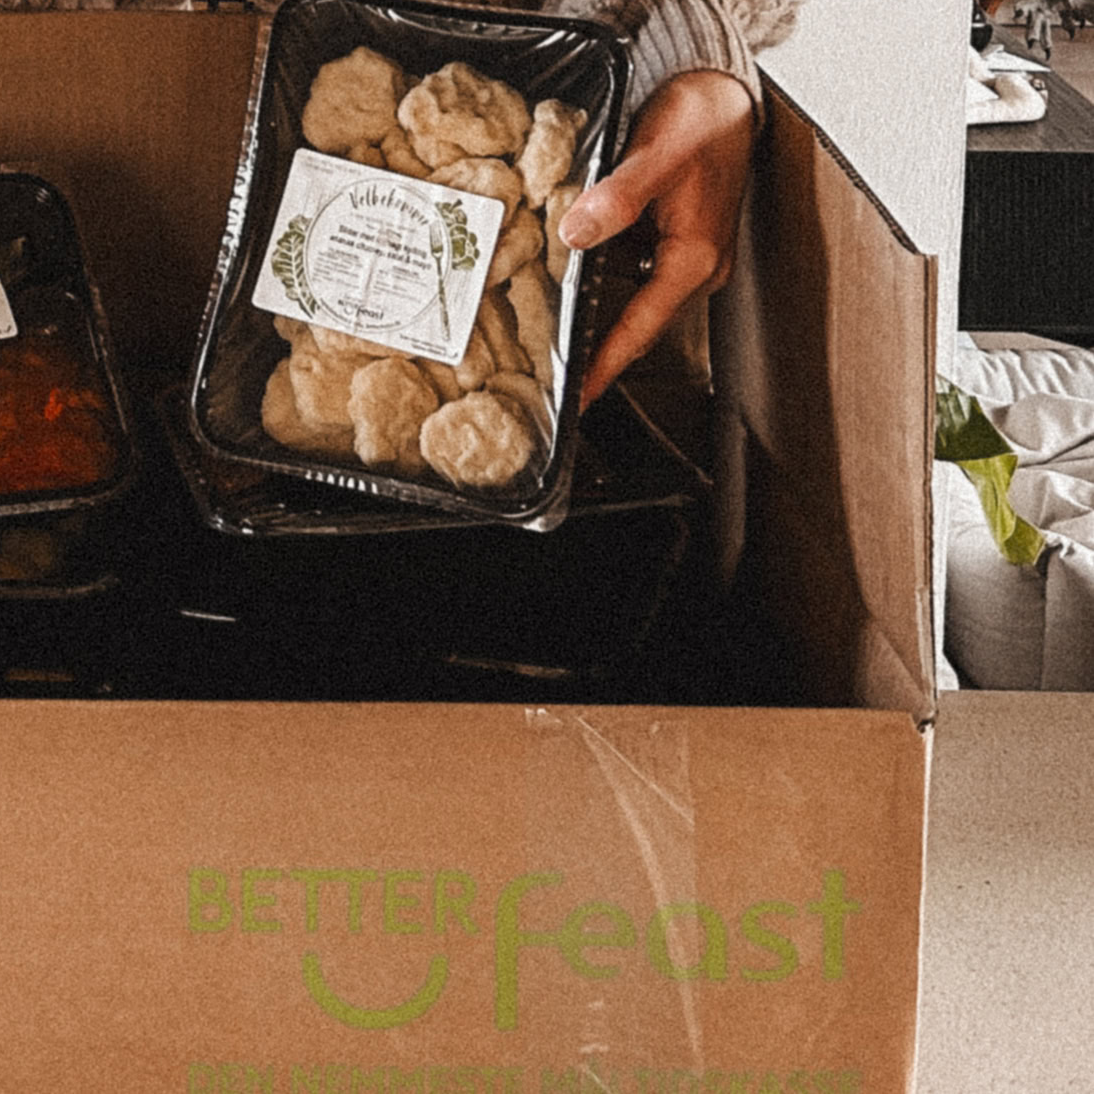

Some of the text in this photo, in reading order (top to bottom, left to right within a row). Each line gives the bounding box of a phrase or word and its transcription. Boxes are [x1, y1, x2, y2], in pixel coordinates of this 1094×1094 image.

[188, 868, 861, 1032] BETTER feast
[188, 1062, 273, 1094] DEN
[290, 1062, 524, 1094] NEMMESTE
